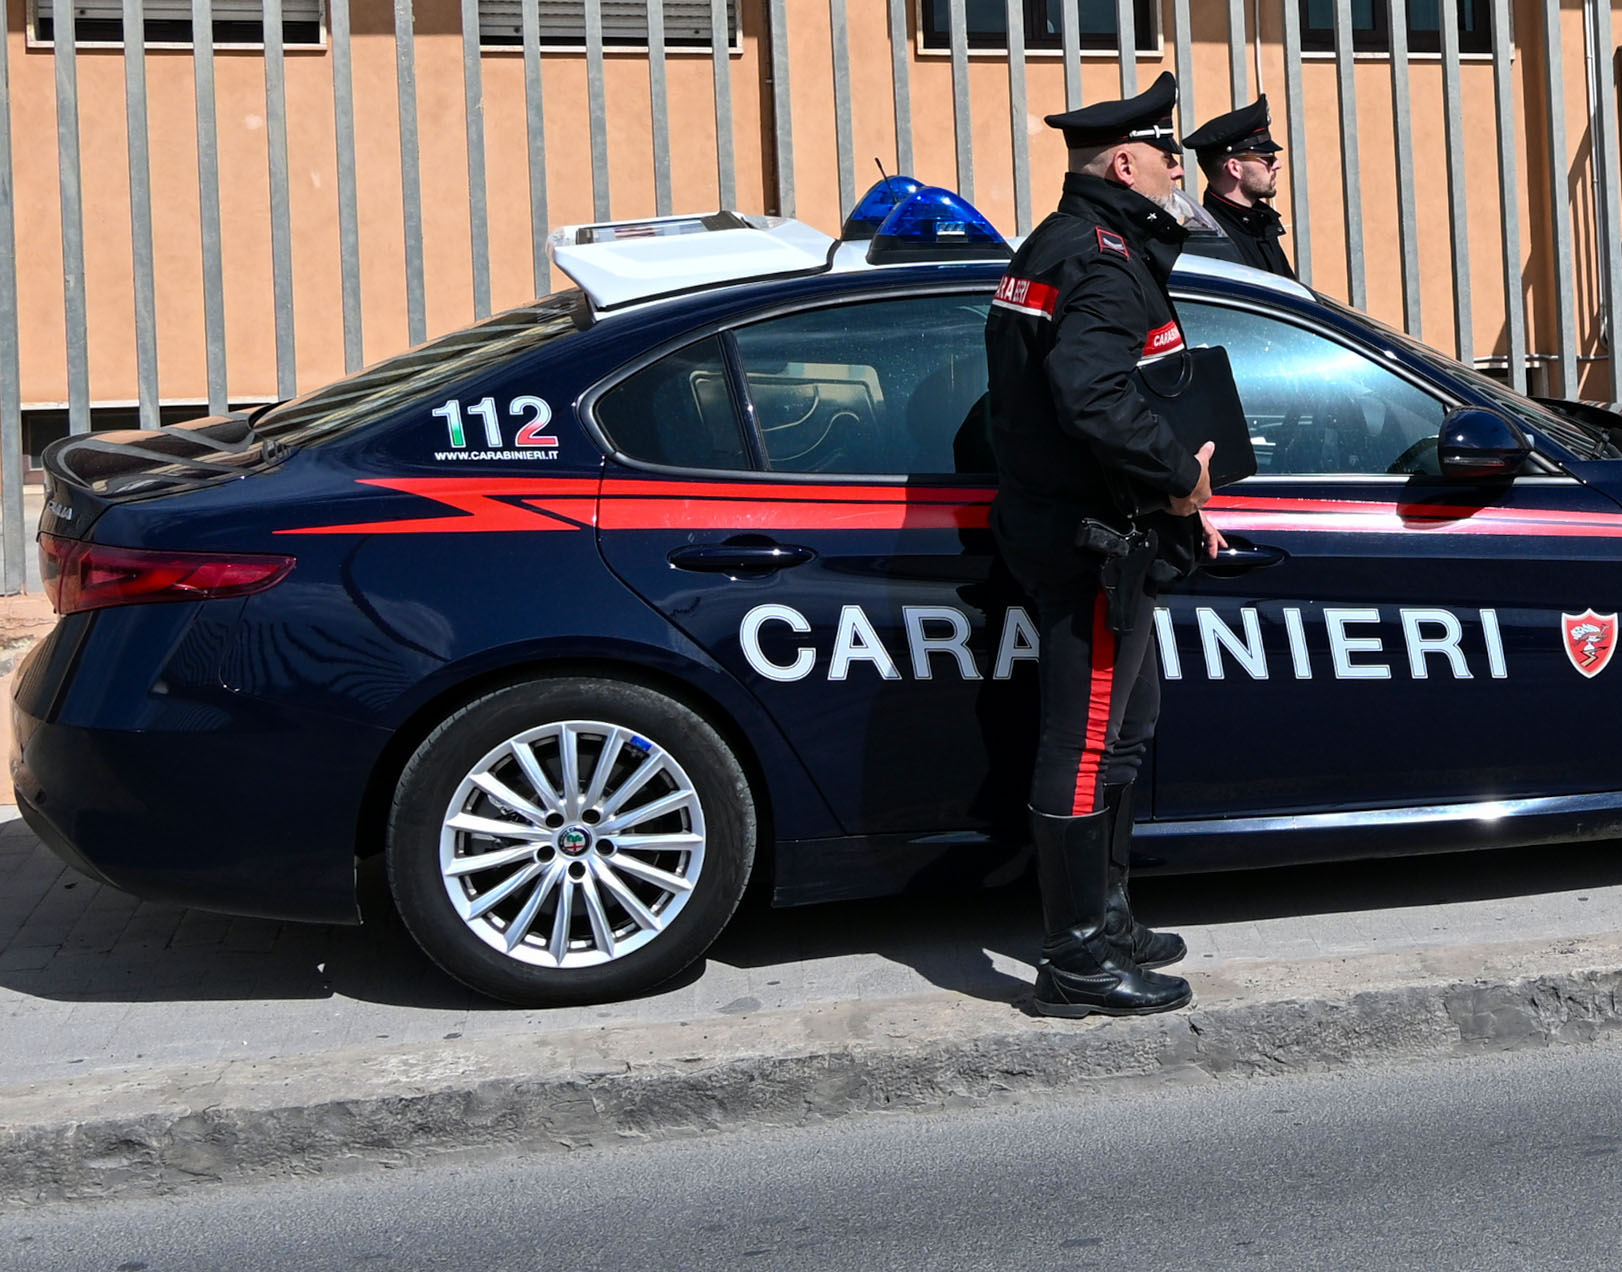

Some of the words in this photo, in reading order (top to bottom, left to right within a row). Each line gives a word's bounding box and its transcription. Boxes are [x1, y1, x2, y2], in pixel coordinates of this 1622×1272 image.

[432, 395, 560, 449] 112
[434, 450, 560, 461] WWW.CARABINIERI.IT
[739, 603, 1508, 682] CARAINIERI
